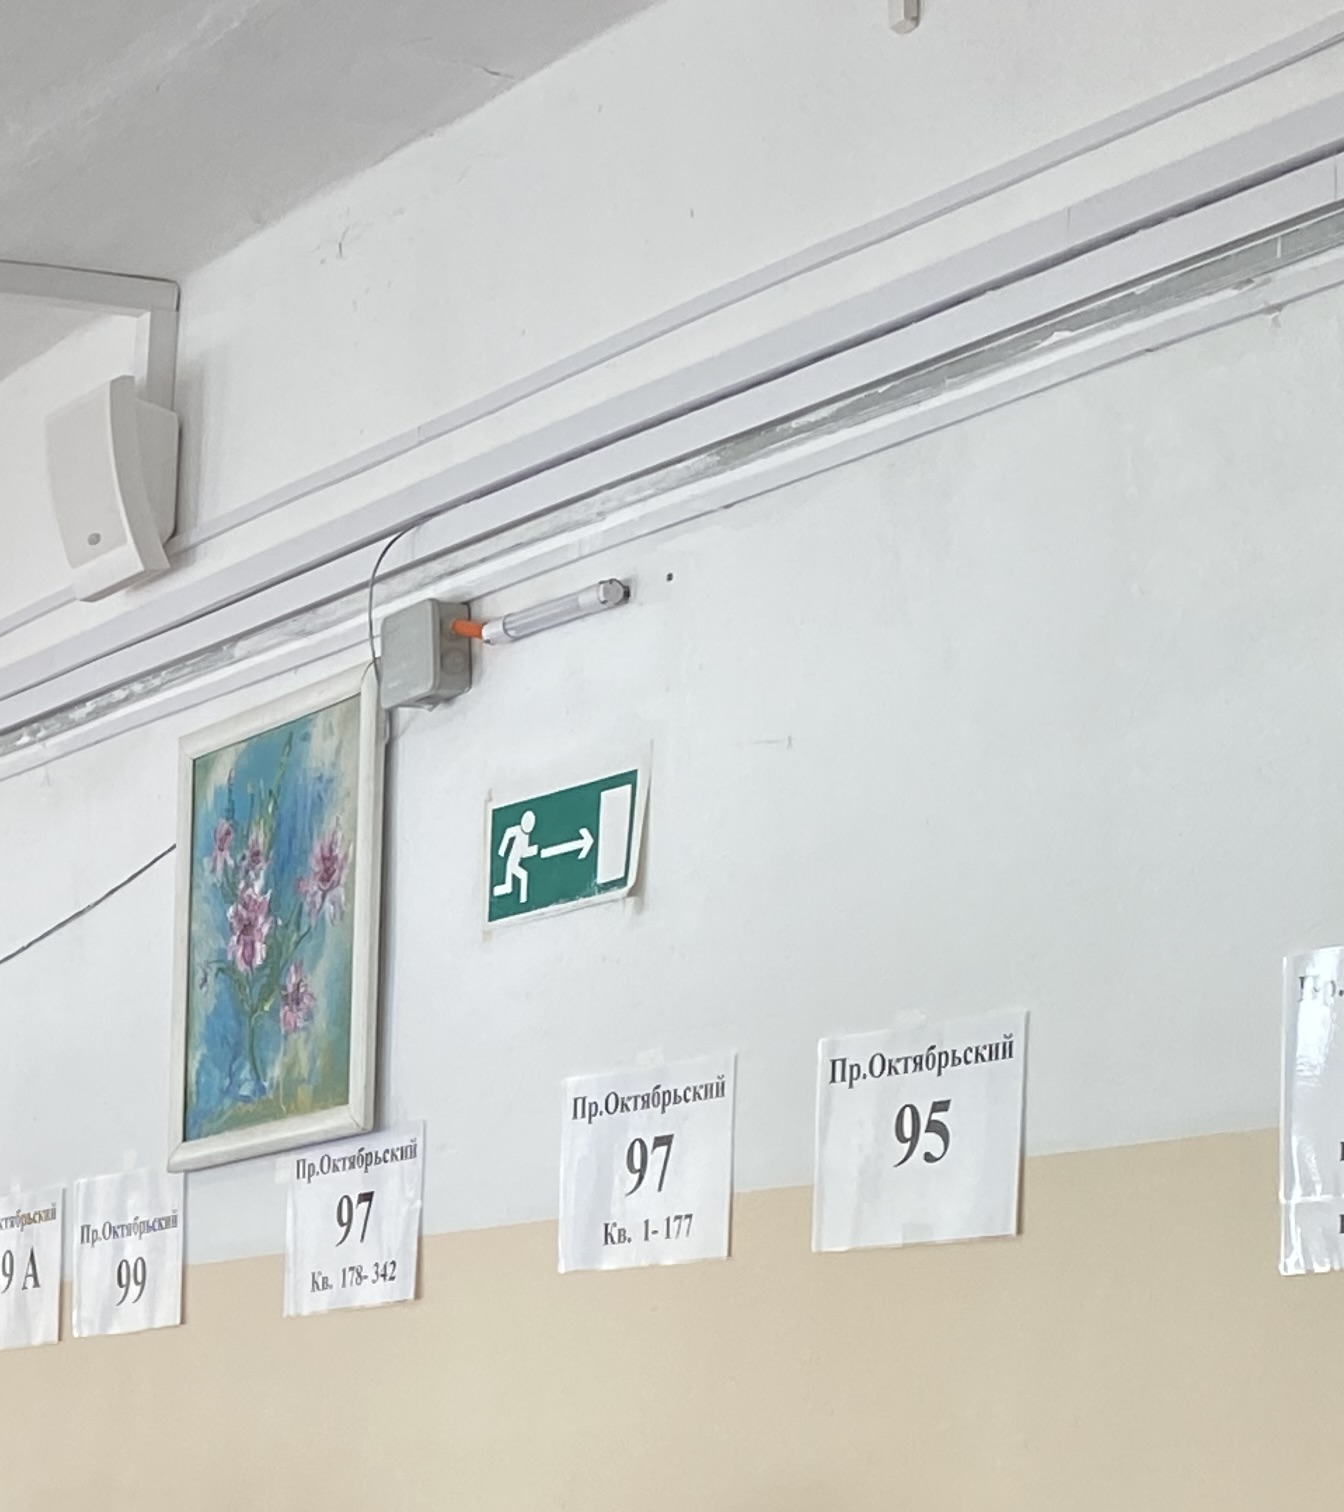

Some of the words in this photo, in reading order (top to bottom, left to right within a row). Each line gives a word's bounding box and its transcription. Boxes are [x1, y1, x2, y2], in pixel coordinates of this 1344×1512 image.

[828, 1033, 1015, 1088] Пр.Октябрьский
[570, 1074, 727, 1124] Пр.Октябрьский
[892, 1099, 952, 1168] 95
[295, 1137, 418, 1184] Пр.Октябрьский
[624, 1133, 675, 1197] 97
[79, 1209, 179, 1247] Пр.Октябрьский
[334, 1190, 376, 1248] 97
[603, 1221, 633, 1246] Кв.
[21, 1245, 41, 1290] А
[115, 1256, 148, 1307] 99
[309, 1270, 334, 1293] Кв.
